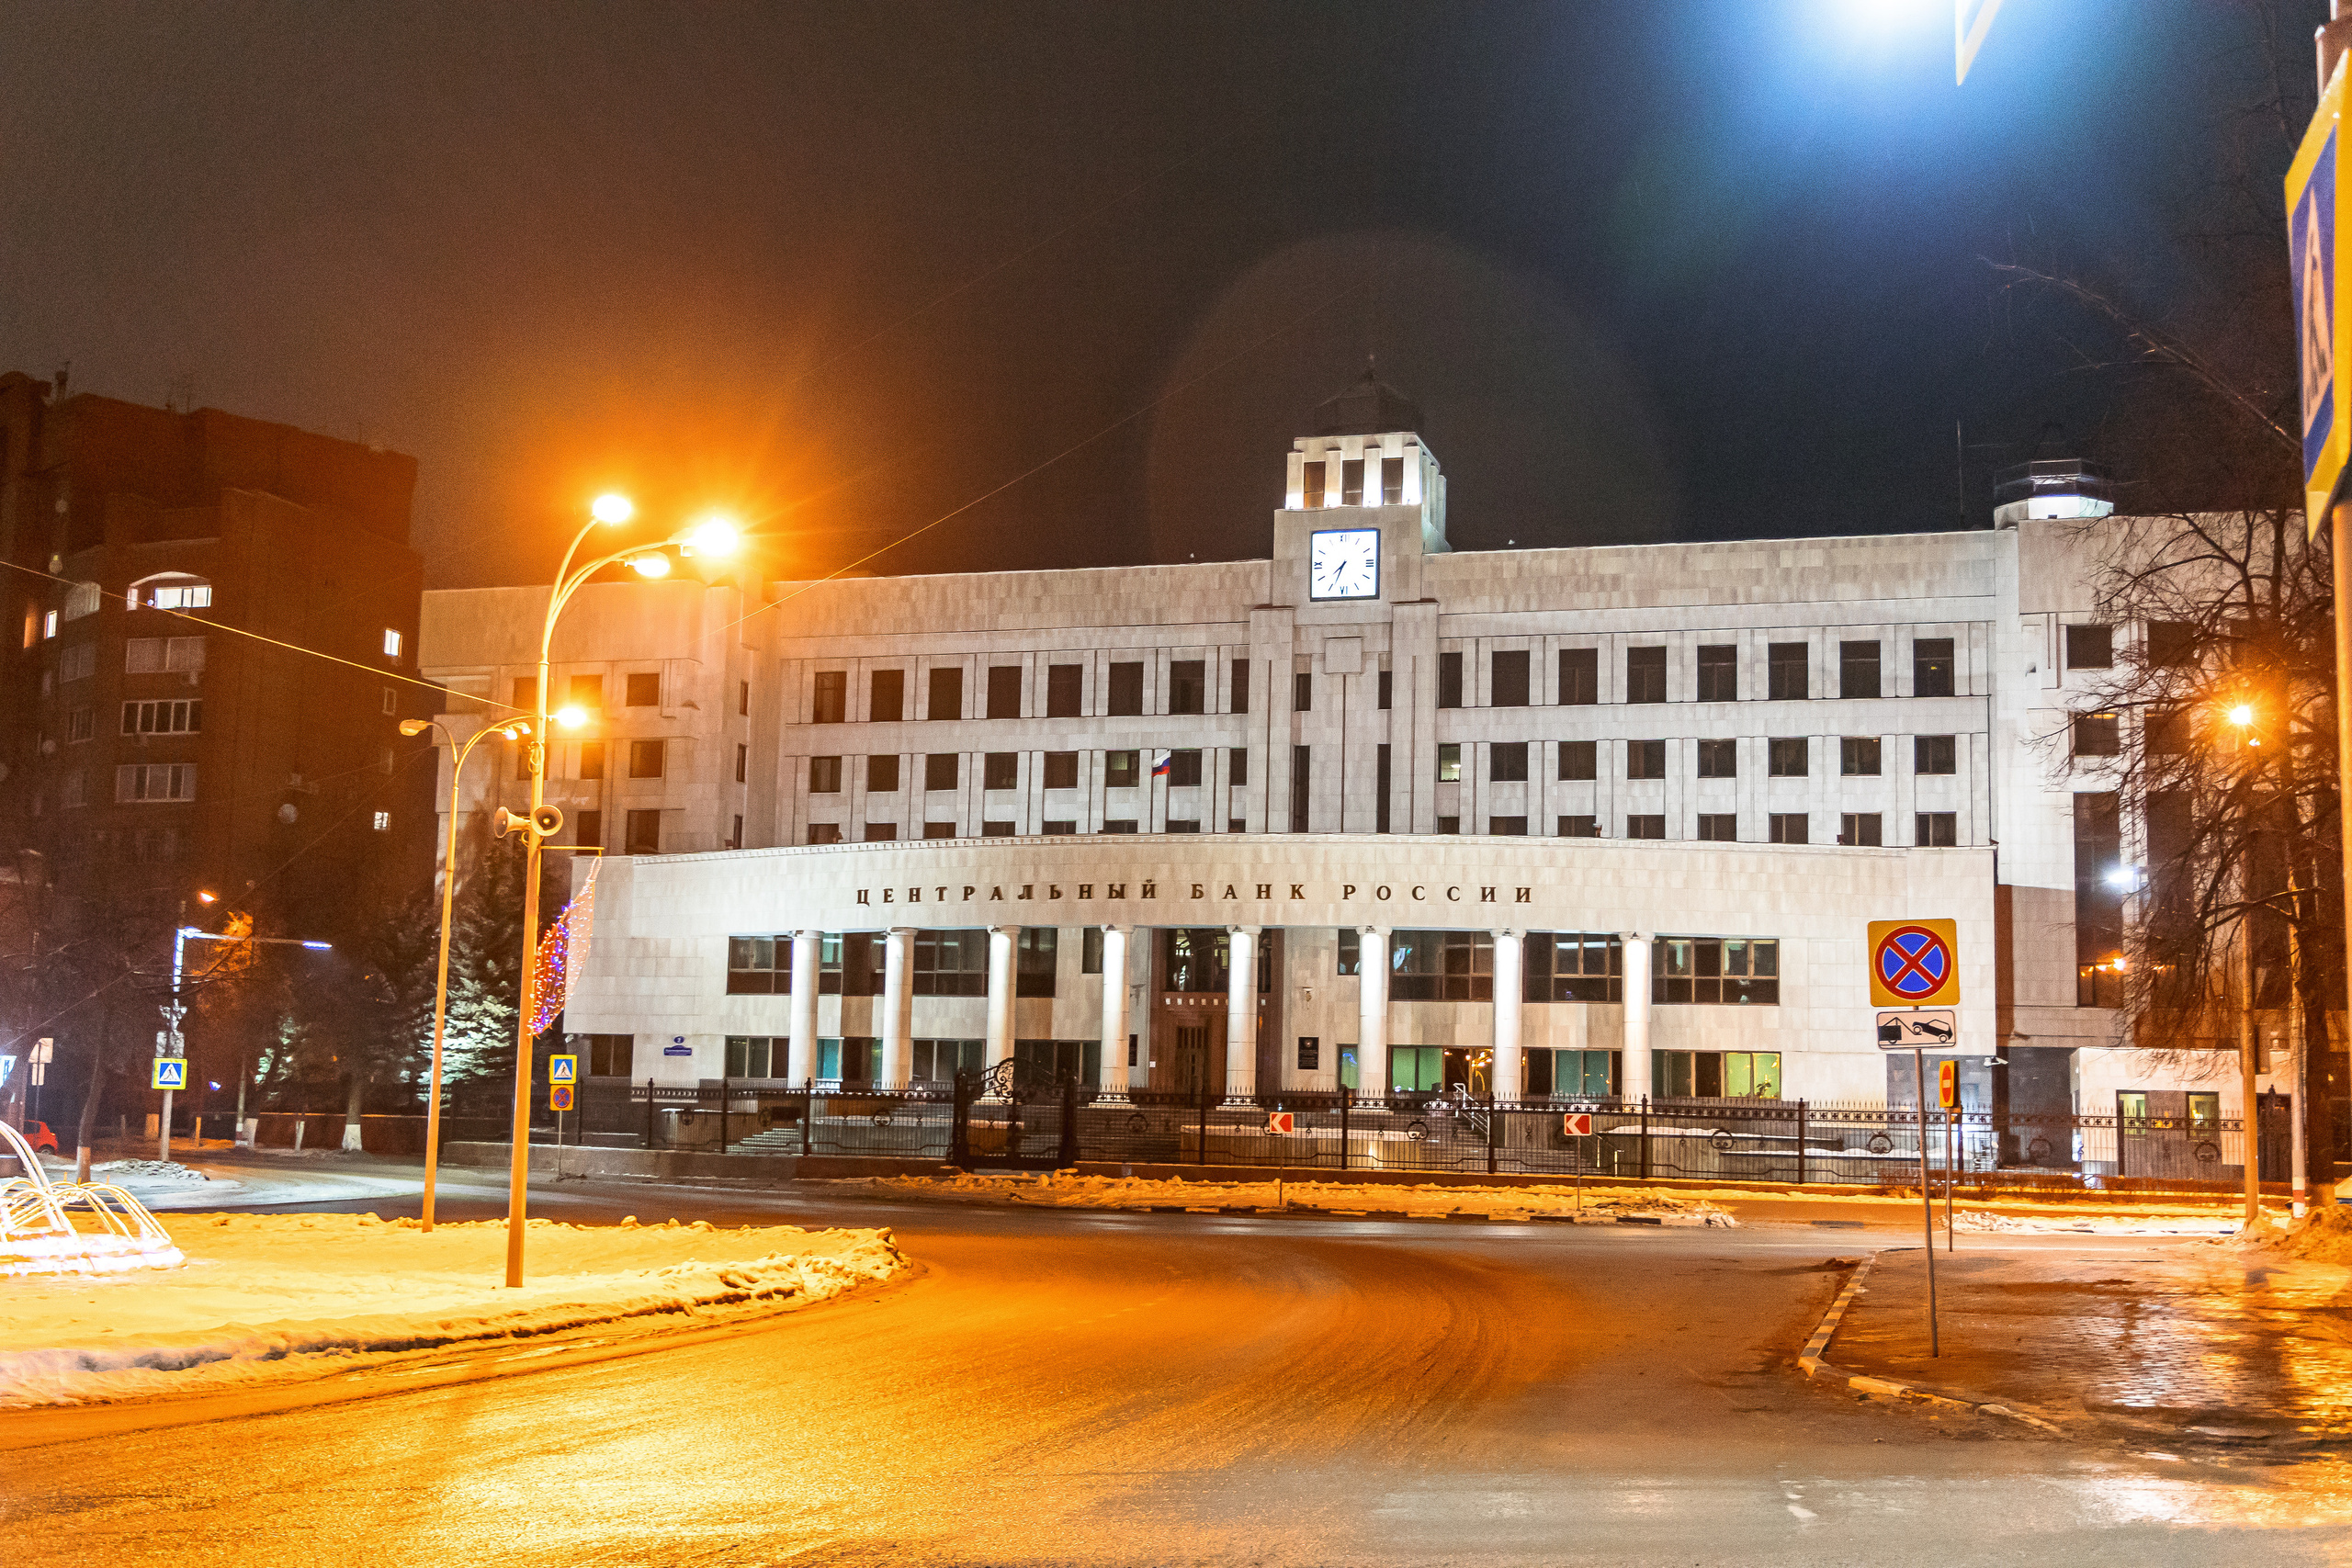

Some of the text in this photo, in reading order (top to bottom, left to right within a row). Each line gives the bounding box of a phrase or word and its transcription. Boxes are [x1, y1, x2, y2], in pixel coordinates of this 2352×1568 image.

[856, 879, 1532, 908] ЦЕНТРАЛЬНЫЙ БАНК РОССИИ
